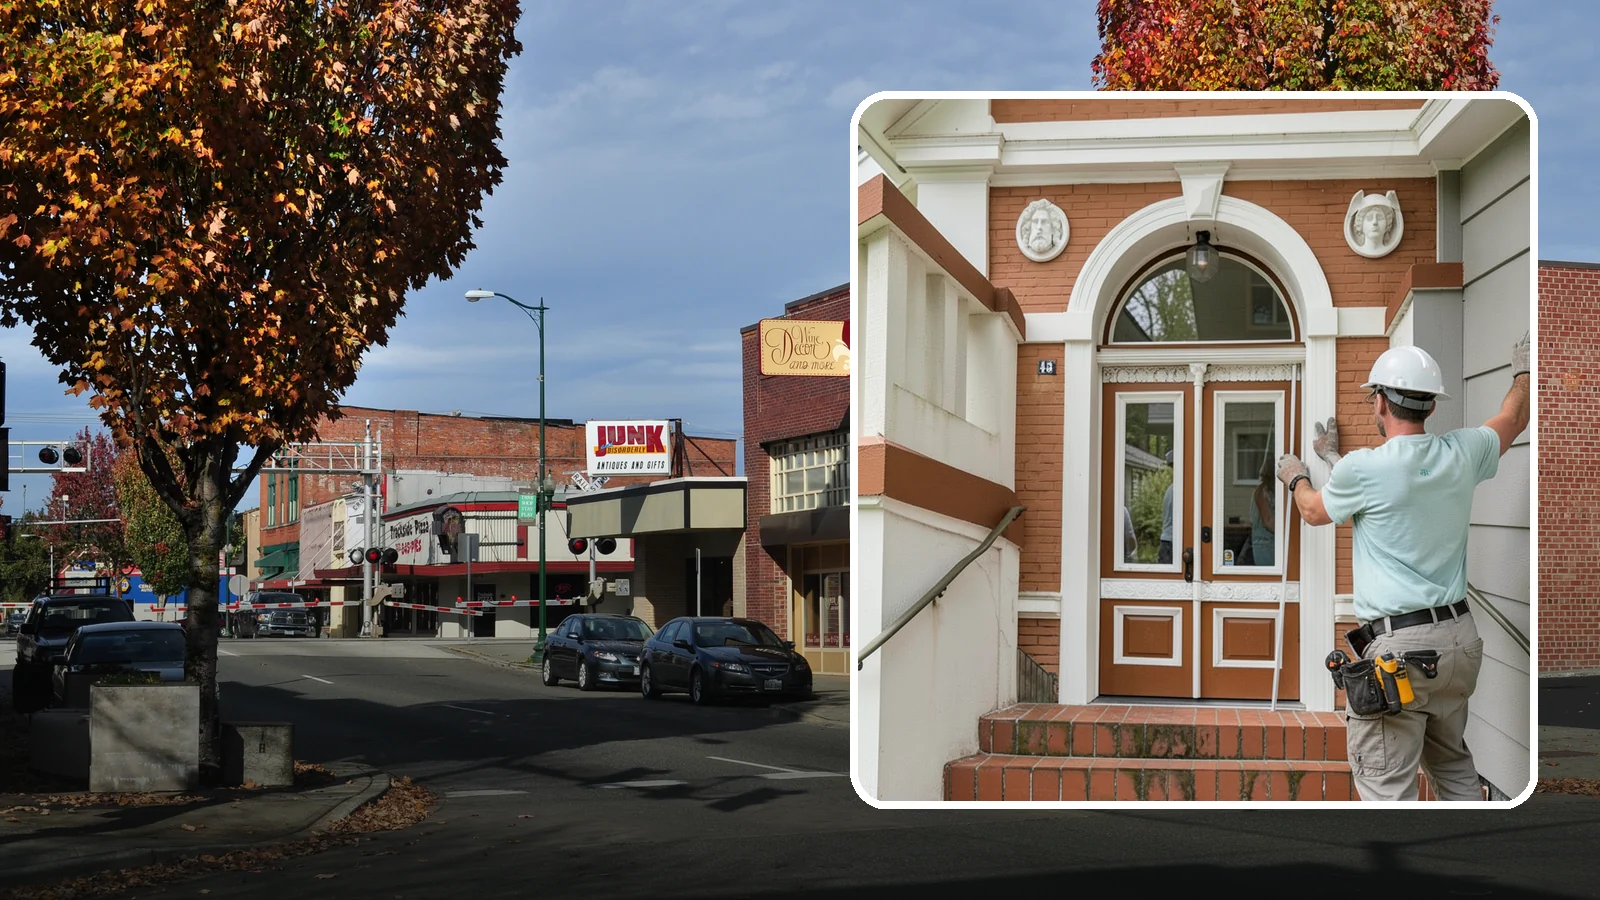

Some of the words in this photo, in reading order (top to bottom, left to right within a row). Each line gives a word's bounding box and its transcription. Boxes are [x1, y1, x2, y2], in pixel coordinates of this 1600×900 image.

[765, 328, 831, 365] Decor
[596, 425, 664, 457] JUNK
[597, 461, 628, 470] ANTIQUES
[631, 461, 644, 470] AND
[647, 460, 665, 470] GIFTS
[414, 519, 429, 535] Pizza
